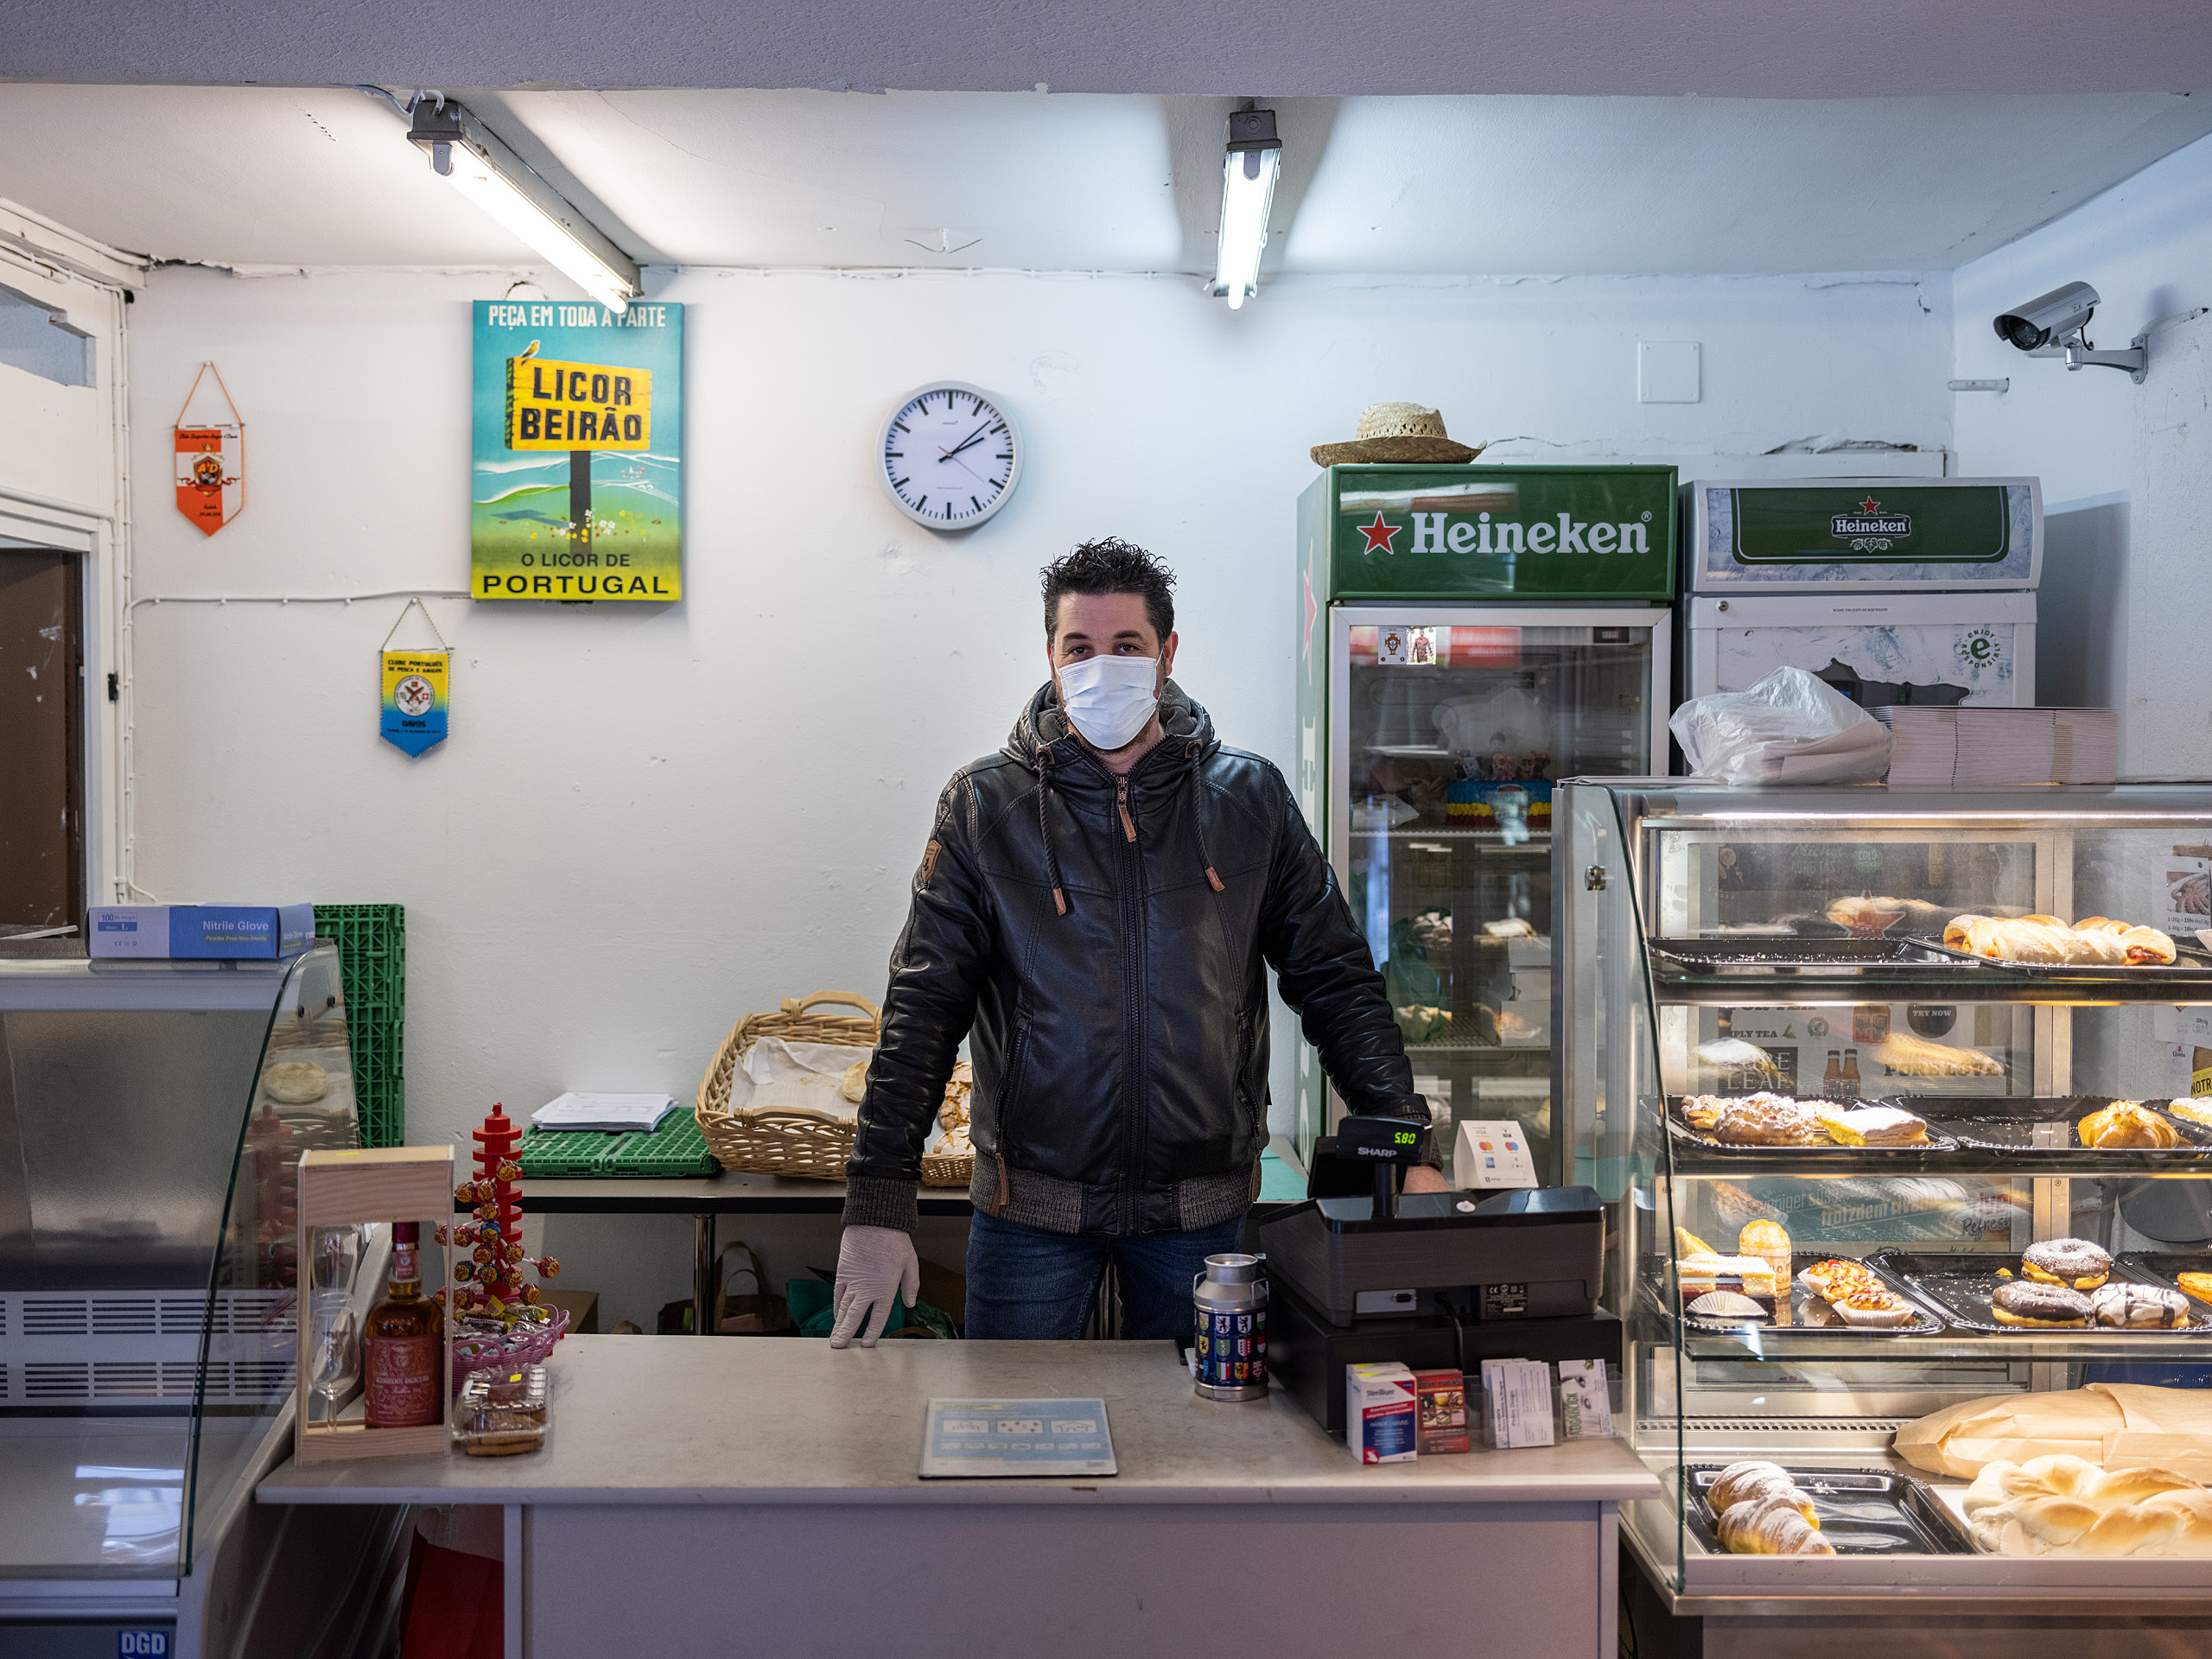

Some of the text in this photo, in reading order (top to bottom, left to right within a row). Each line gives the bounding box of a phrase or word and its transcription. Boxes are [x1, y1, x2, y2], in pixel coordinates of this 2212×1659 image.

[489, 305, 527, 330] PEÇA
[531, 305, 553, 327] EM
[558, 306, 597, 327] TODA
[617, 307, 665, 327] PARTE
[532, 366, 632, 406] LICOR
[520, 406, 642, 442] BEIRÃO
[1410, 512, 1650, 554] Heineken
[1835, 519, 1907, 532] Heineken
[521, 554, 630, 567] O LICOR DE
[483, 575, 669, 594] PORTUGAL
[203, 921, 269, 931] Nitrile Glove
[1357, 1147, 1397, 1157] SHARP
[1962, 1213, 2012, 1240] Refresh
[122, 1633, 165, 1654] DGD
